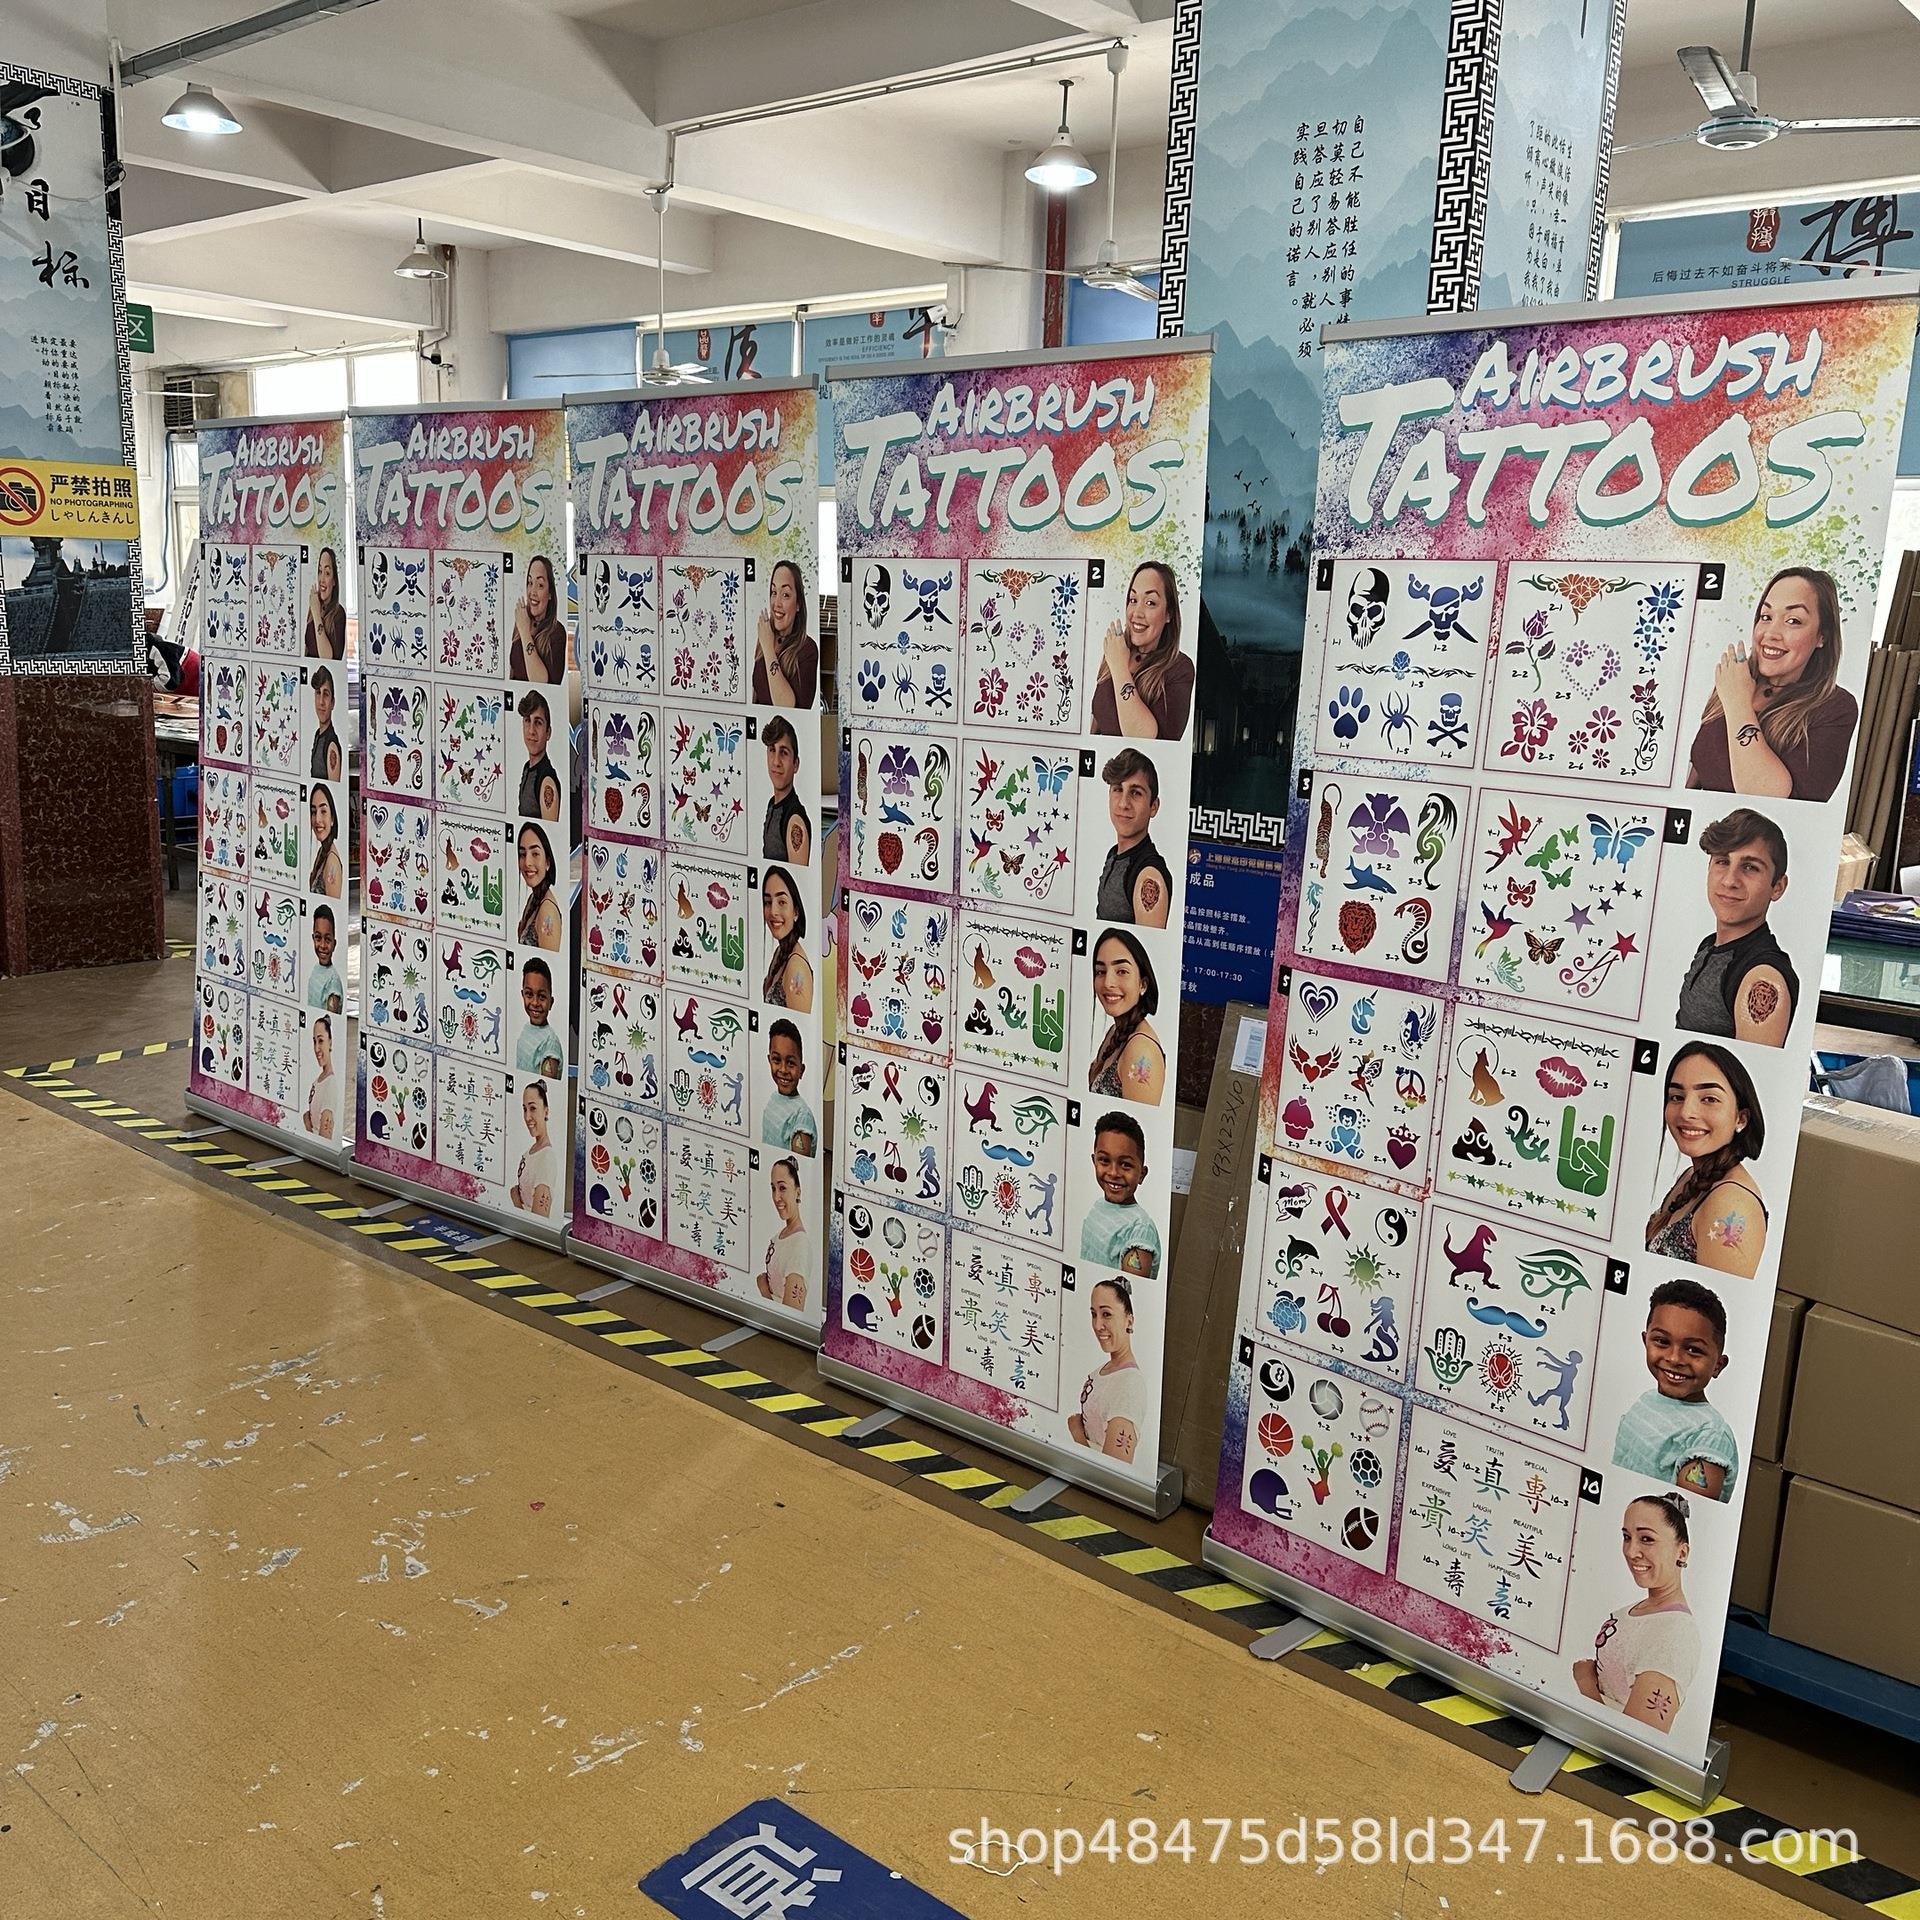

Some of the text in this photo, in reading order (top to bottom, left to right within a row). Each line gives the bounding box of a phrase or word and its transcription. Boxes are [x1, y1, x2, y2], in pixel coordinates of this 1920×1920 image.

[1652, 261, 1792, 283] 后悔过去不如奋斗将来
[1731, 274, 1792, 289] STRUGGLE
[1460, 327, 1824, 411] AIRBRUSH
[926, 375, 1155, 440] AIRBRUSH
[630, 407, 781, 454] AIRBRUSH
[407, 421, 535, 461] AIRBRUSH
[235, 433, 324, 468] AIRBRUSH
[1338, 375, 1867, 530] TATTOOS
[844, 412, 1186, 534] TATTOOS
[49, 474, 133, 498] 严禁拍照
[201, 451, 337, 529] TATTOOS
[358, 441, 554, 534] TATTOOS
[576, 432, 804, 536] TATTOOS
[50, 498, 133, 509] NO PHOTOGRAPHING
[51, 509, 135, 525] しゃしんきんし
[1092, 567, 1101, 579] 2
[1705, 574, 1718, 589] 2
[1303, 778, 1310, 790] 3
[1077, 937, 1083, 948] 6
[1194, 966, 1243, 982] 17:00-17:30
[1283, 975, 1291, 989] 5
[1641, 1050, 1650, 1064] 6
[1064, 1271, 1074, 1283] 10
[1614, 1270, 1624, 1283] 8
[1245, 1347, 1251, 1358] 9
[1275, 1366, 1284, 1383] 8
[1443, 1429, 1457, 1438] LOVE
[1486, 1445, 1505, 1457] TRUTH
[1523, 1460, 1548, 1474] SPECIAL
[1473, 1457, 1510, 1501] 真
[1583, 1477, 1599, 1494] 10
[1421, 1481, 1451, 1497] EXPENSIVE
[1472, 1502, 1492, 1514] LAUGH
[1462, 1513, 1494, 1557] 笑
[1512, 1519, 1543, 1535] BEAUTIFUL
[1442, 1542, 1472, 1560] LONG LIFE
[1508, 1532, 1543, 1580] 美
[1488, 1562, 1520, 1580] HAPPINESS
